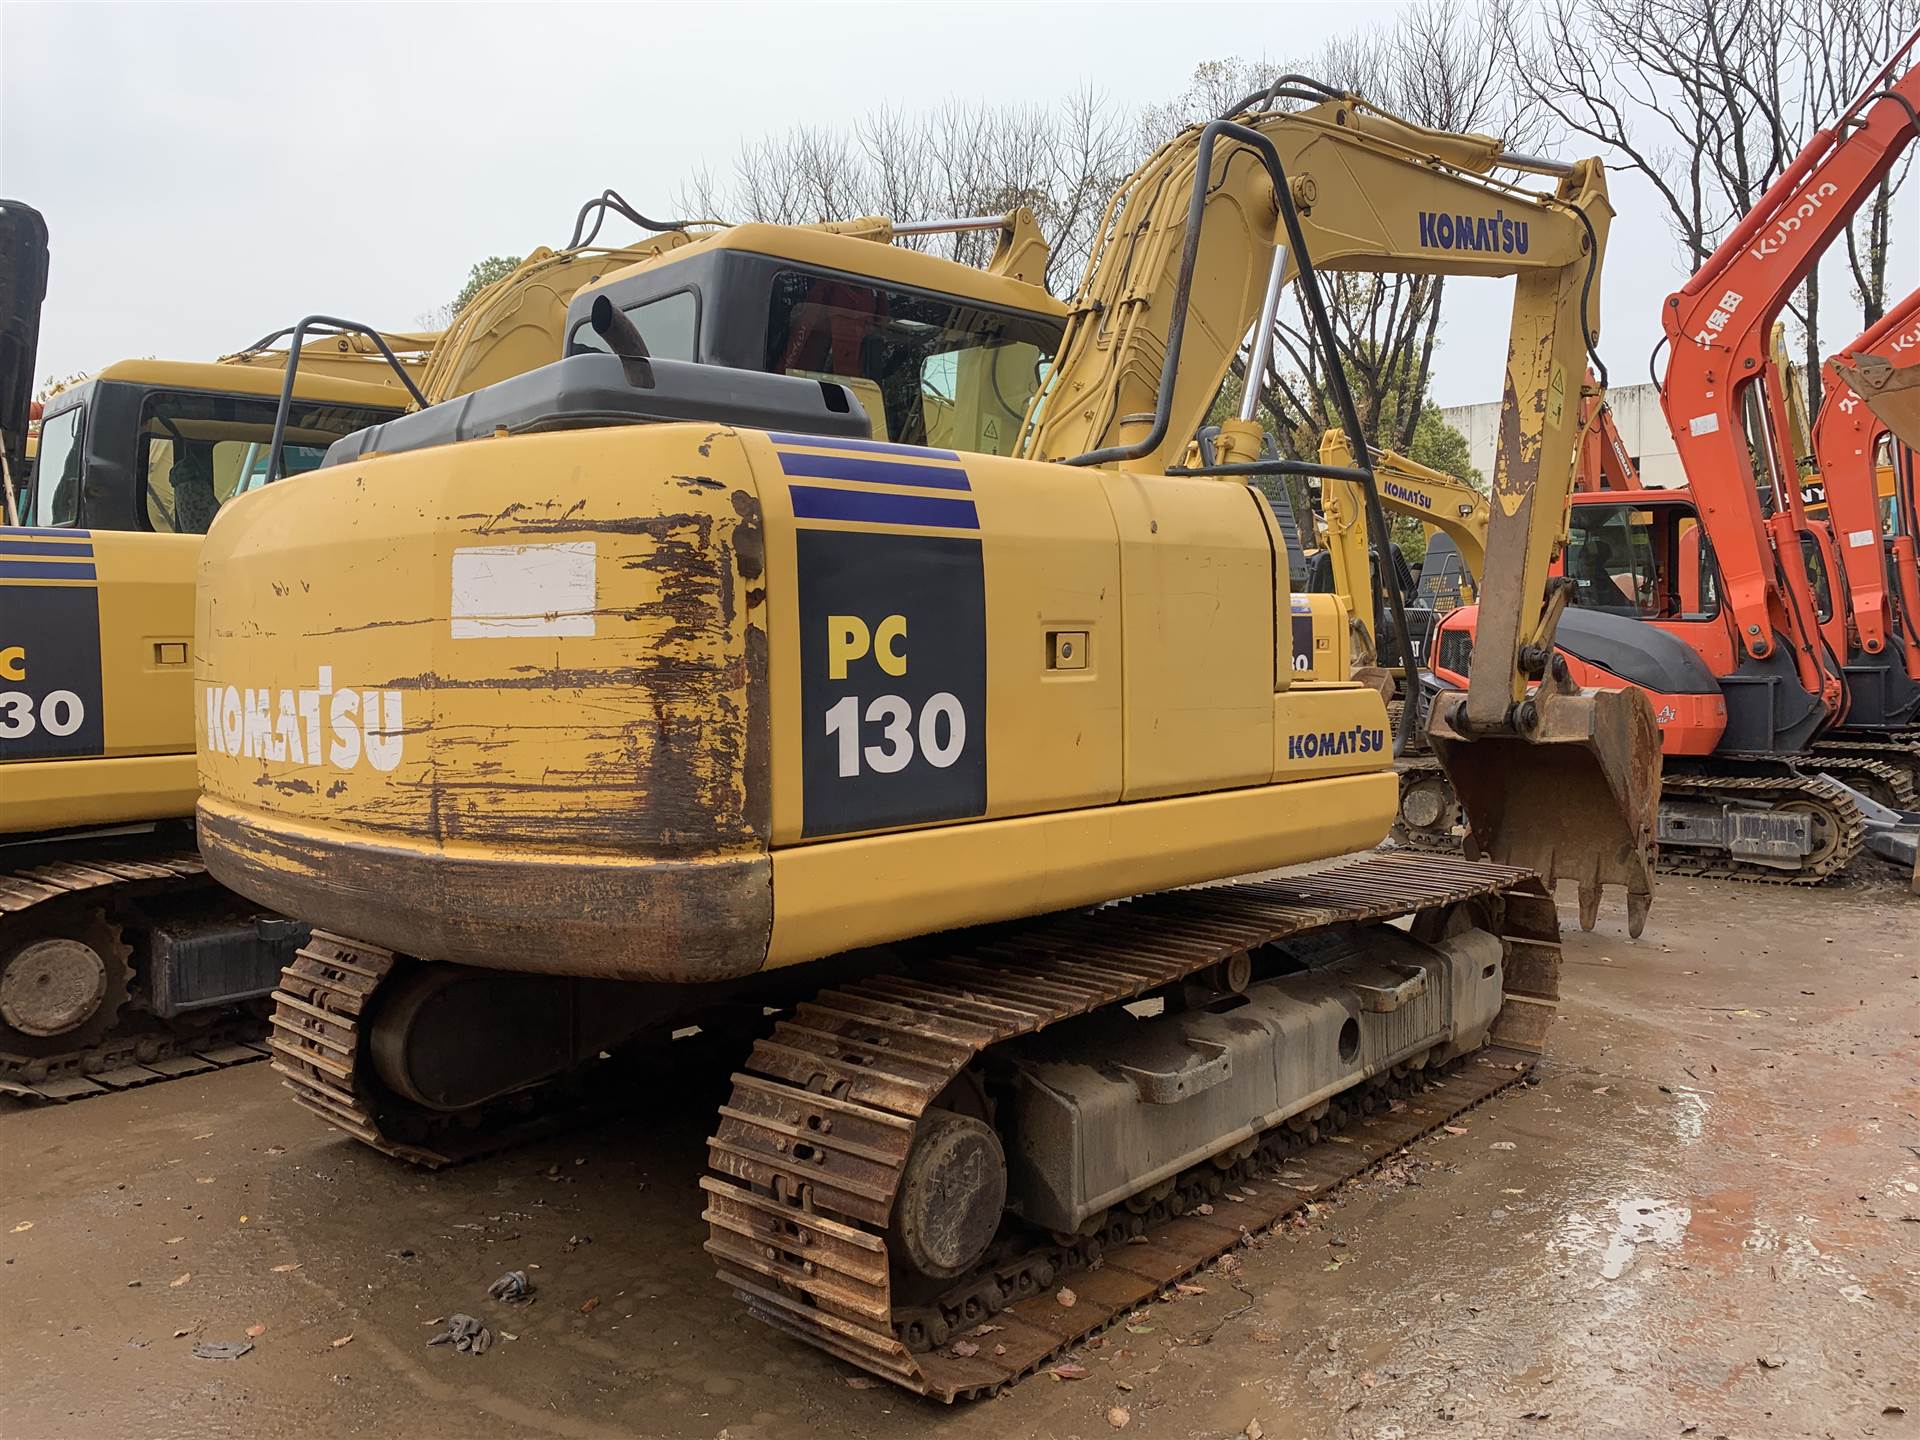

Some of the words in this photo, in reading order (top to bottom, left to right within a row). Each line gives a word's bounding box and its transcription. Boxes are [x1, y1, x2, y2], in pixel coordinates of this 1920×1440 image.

[1418, 209, 1529, 255] KOMATSU
[1750, 182, 1839, 260] Kubota
[1694, 290, 1744, 351] 久保田
[1383, 480, 1432, 509] KOMATSU
[827, 614, 908, 680] PC
[206, 665, 404, 772] KOMATSU
[825, 691, 967, 778] 130
[1288, 725, 1384, 760] KOMATSU
